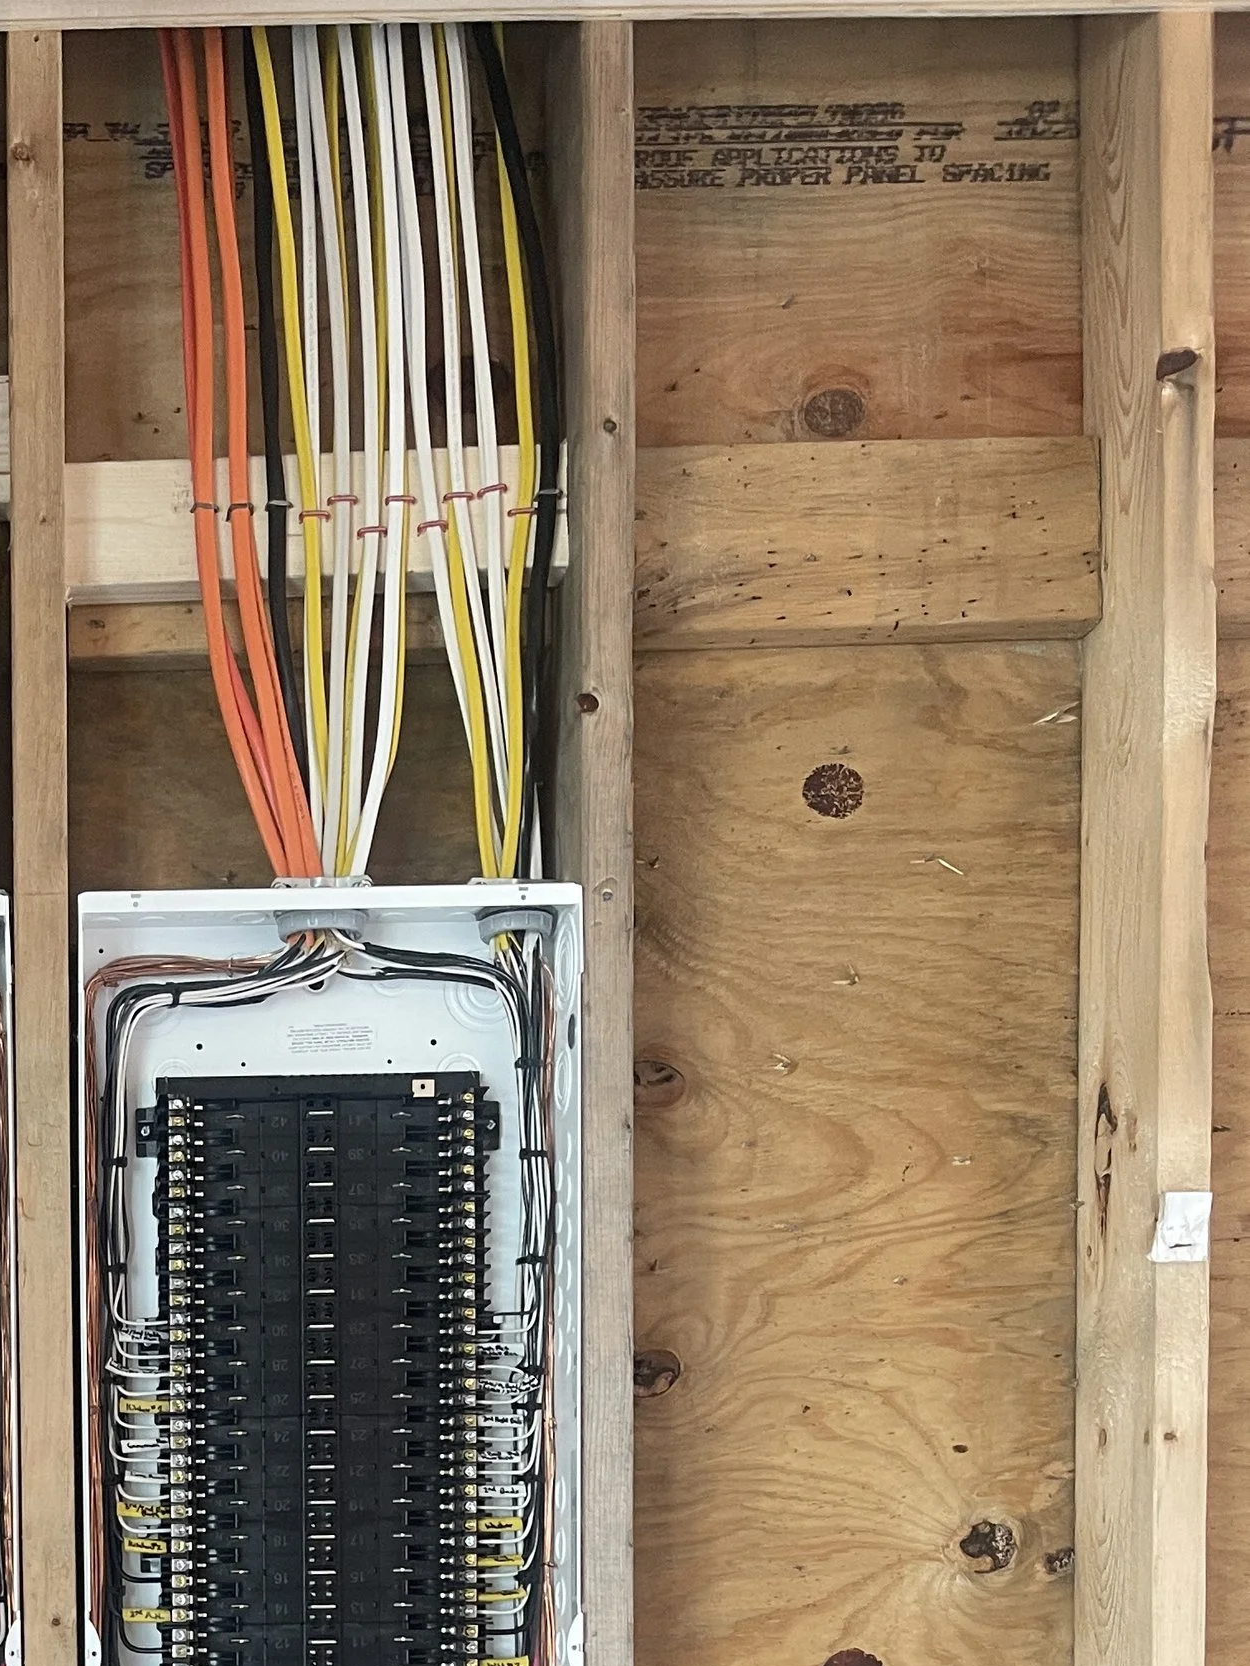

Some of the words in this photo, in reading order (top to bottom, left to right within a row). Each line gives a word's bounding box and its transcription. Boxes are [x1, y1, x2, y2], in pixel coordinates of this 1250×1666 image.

[711, 145, 898, 166] APPLICATIONS
[739, 167, 831, 187] PROPER
[843, 164, 926, 184] PANEL
[942, 162, 1051, 183] SPACING
